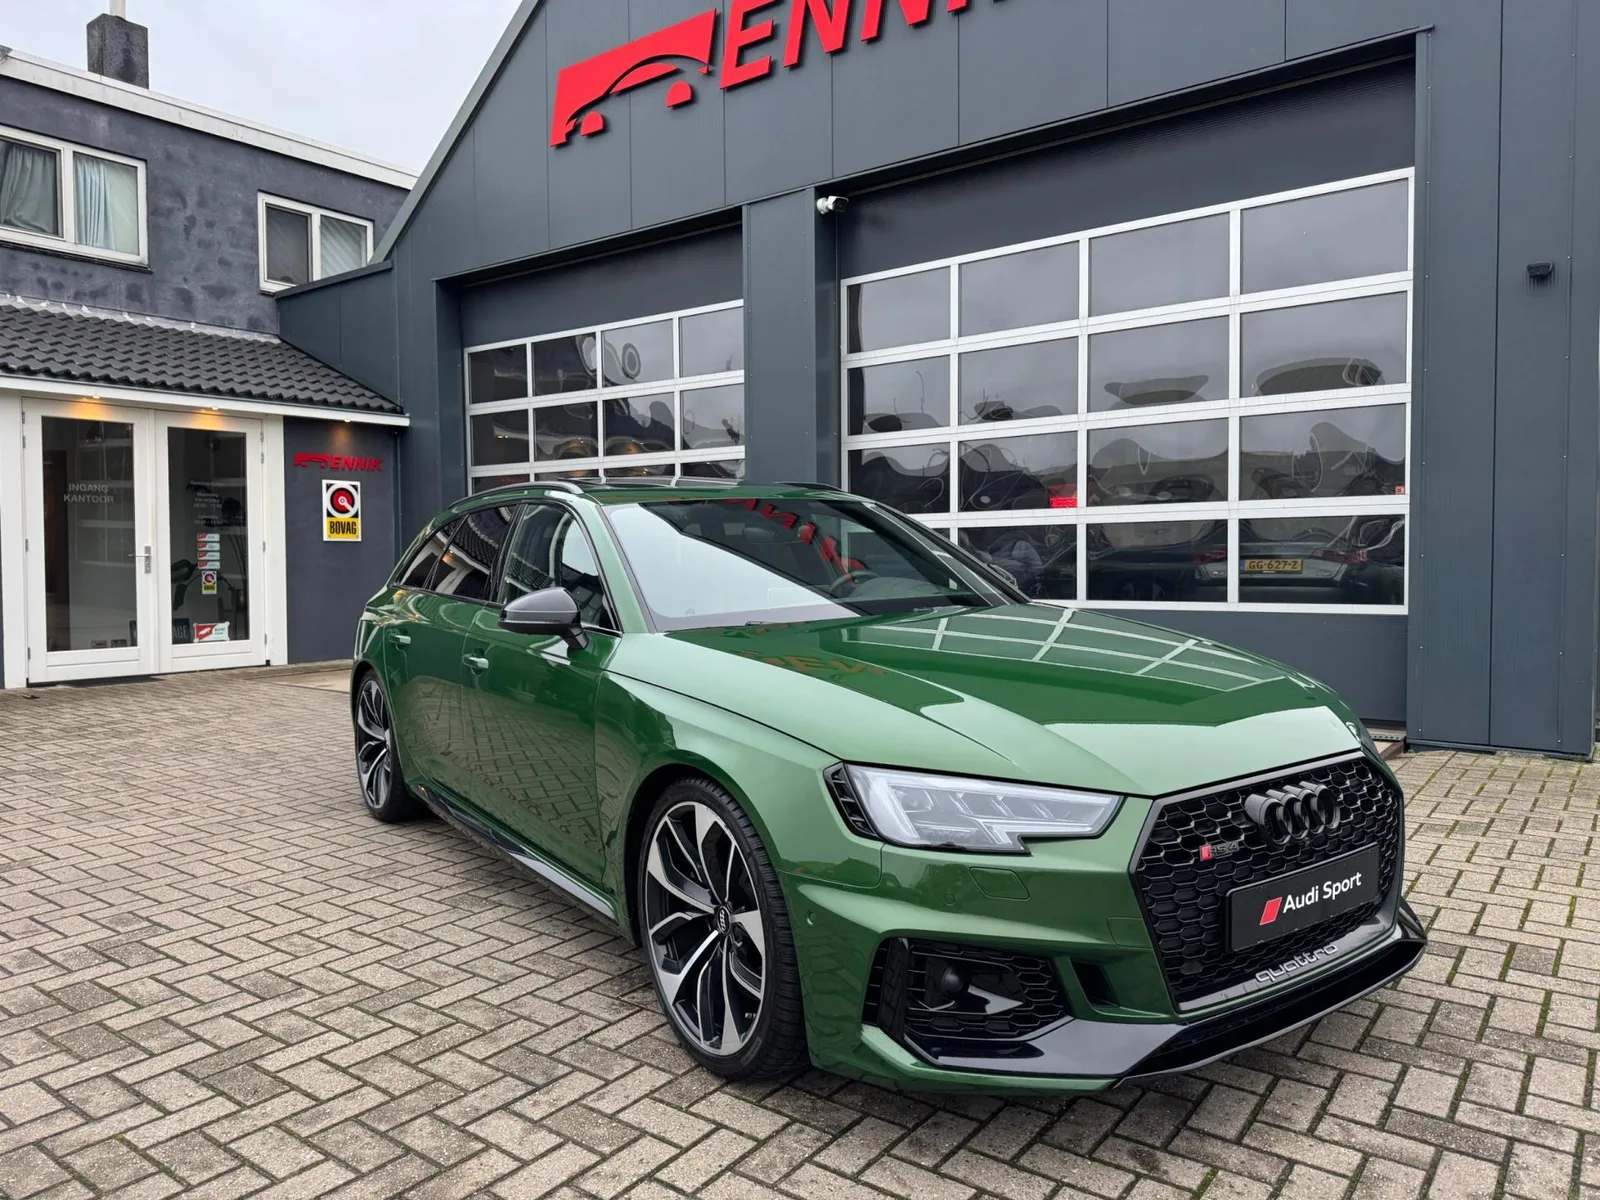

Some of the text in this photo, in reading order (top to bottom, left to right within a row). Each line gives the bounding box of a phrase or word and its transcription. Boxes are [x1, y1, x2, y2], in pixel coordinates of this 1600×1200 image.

[69, 483, 108, 493] INGANG
[63, 494, 114, 503] KANTOOR
[329, 520, 357, 535] BOVAG
[1248, 560, 1299, 570] GG-627-Z
[1282, 871, 1362, 913] Audi Sport
[1255, 944, 1338, 982] quattro
